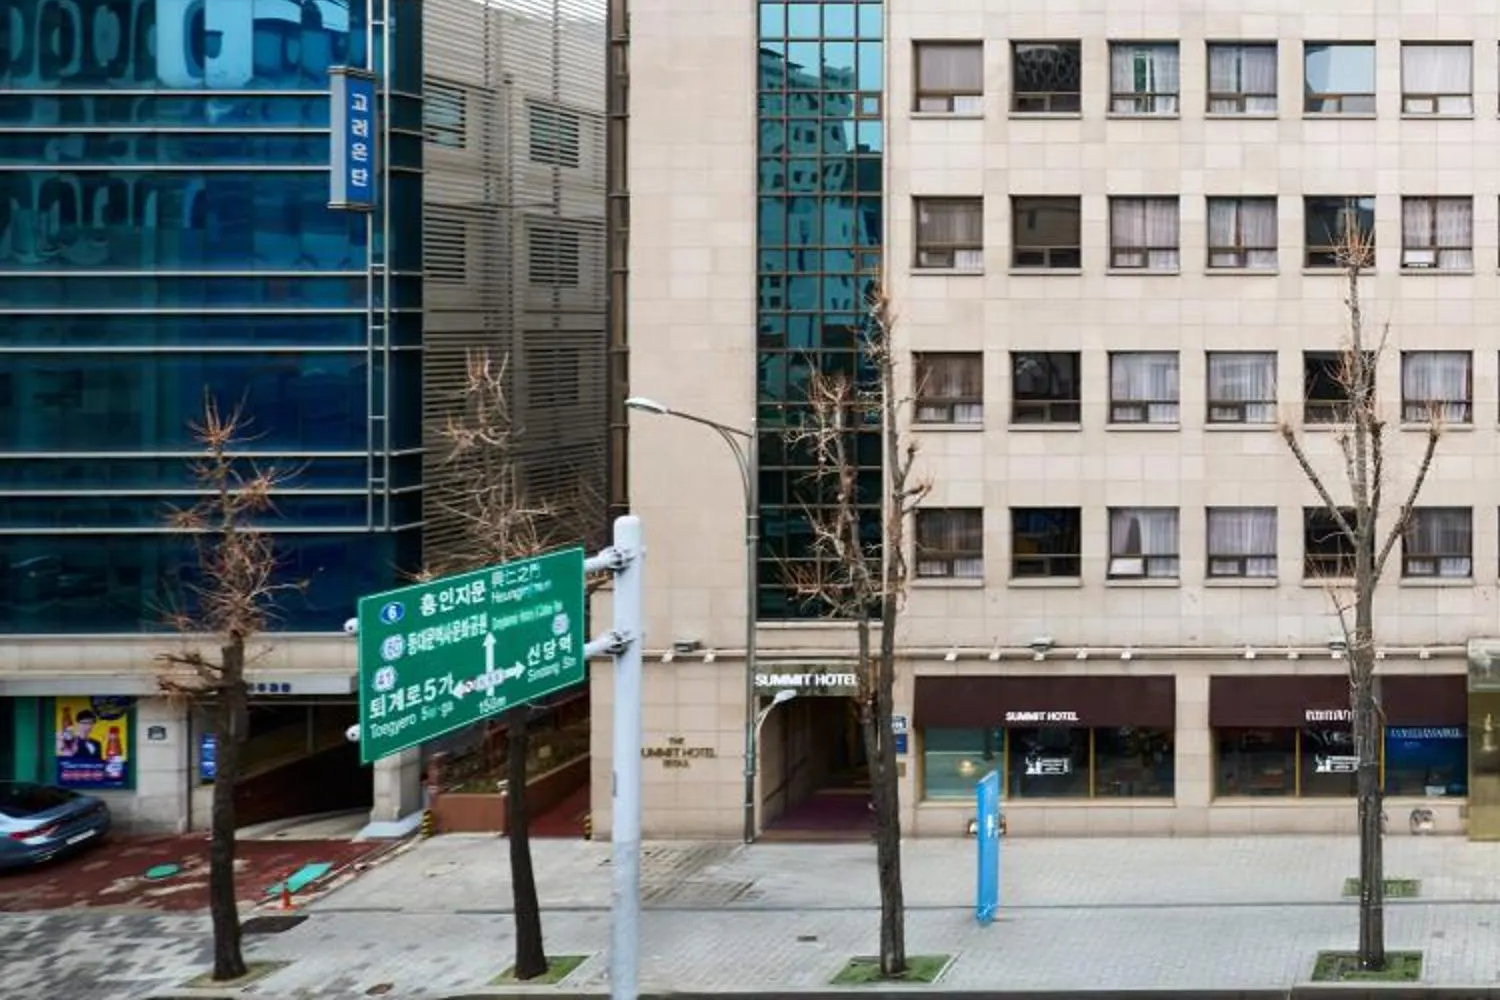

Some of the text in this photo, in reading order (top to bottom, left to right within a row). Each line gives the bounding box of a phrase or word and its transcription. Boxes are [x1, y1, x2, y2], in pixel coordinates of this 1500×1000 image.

[419, 579, 486, 617] 흥인지문
[526, 633, 572, 667] 신당역
[755, 672, 858, 687] SUMMIT HOTEL
[369, 672, 455, 719] 퇴계로5가
[1005, 711, 1080, 721] SUMMIT HOTEL
[640, 747, 680, 758] UMMIT
